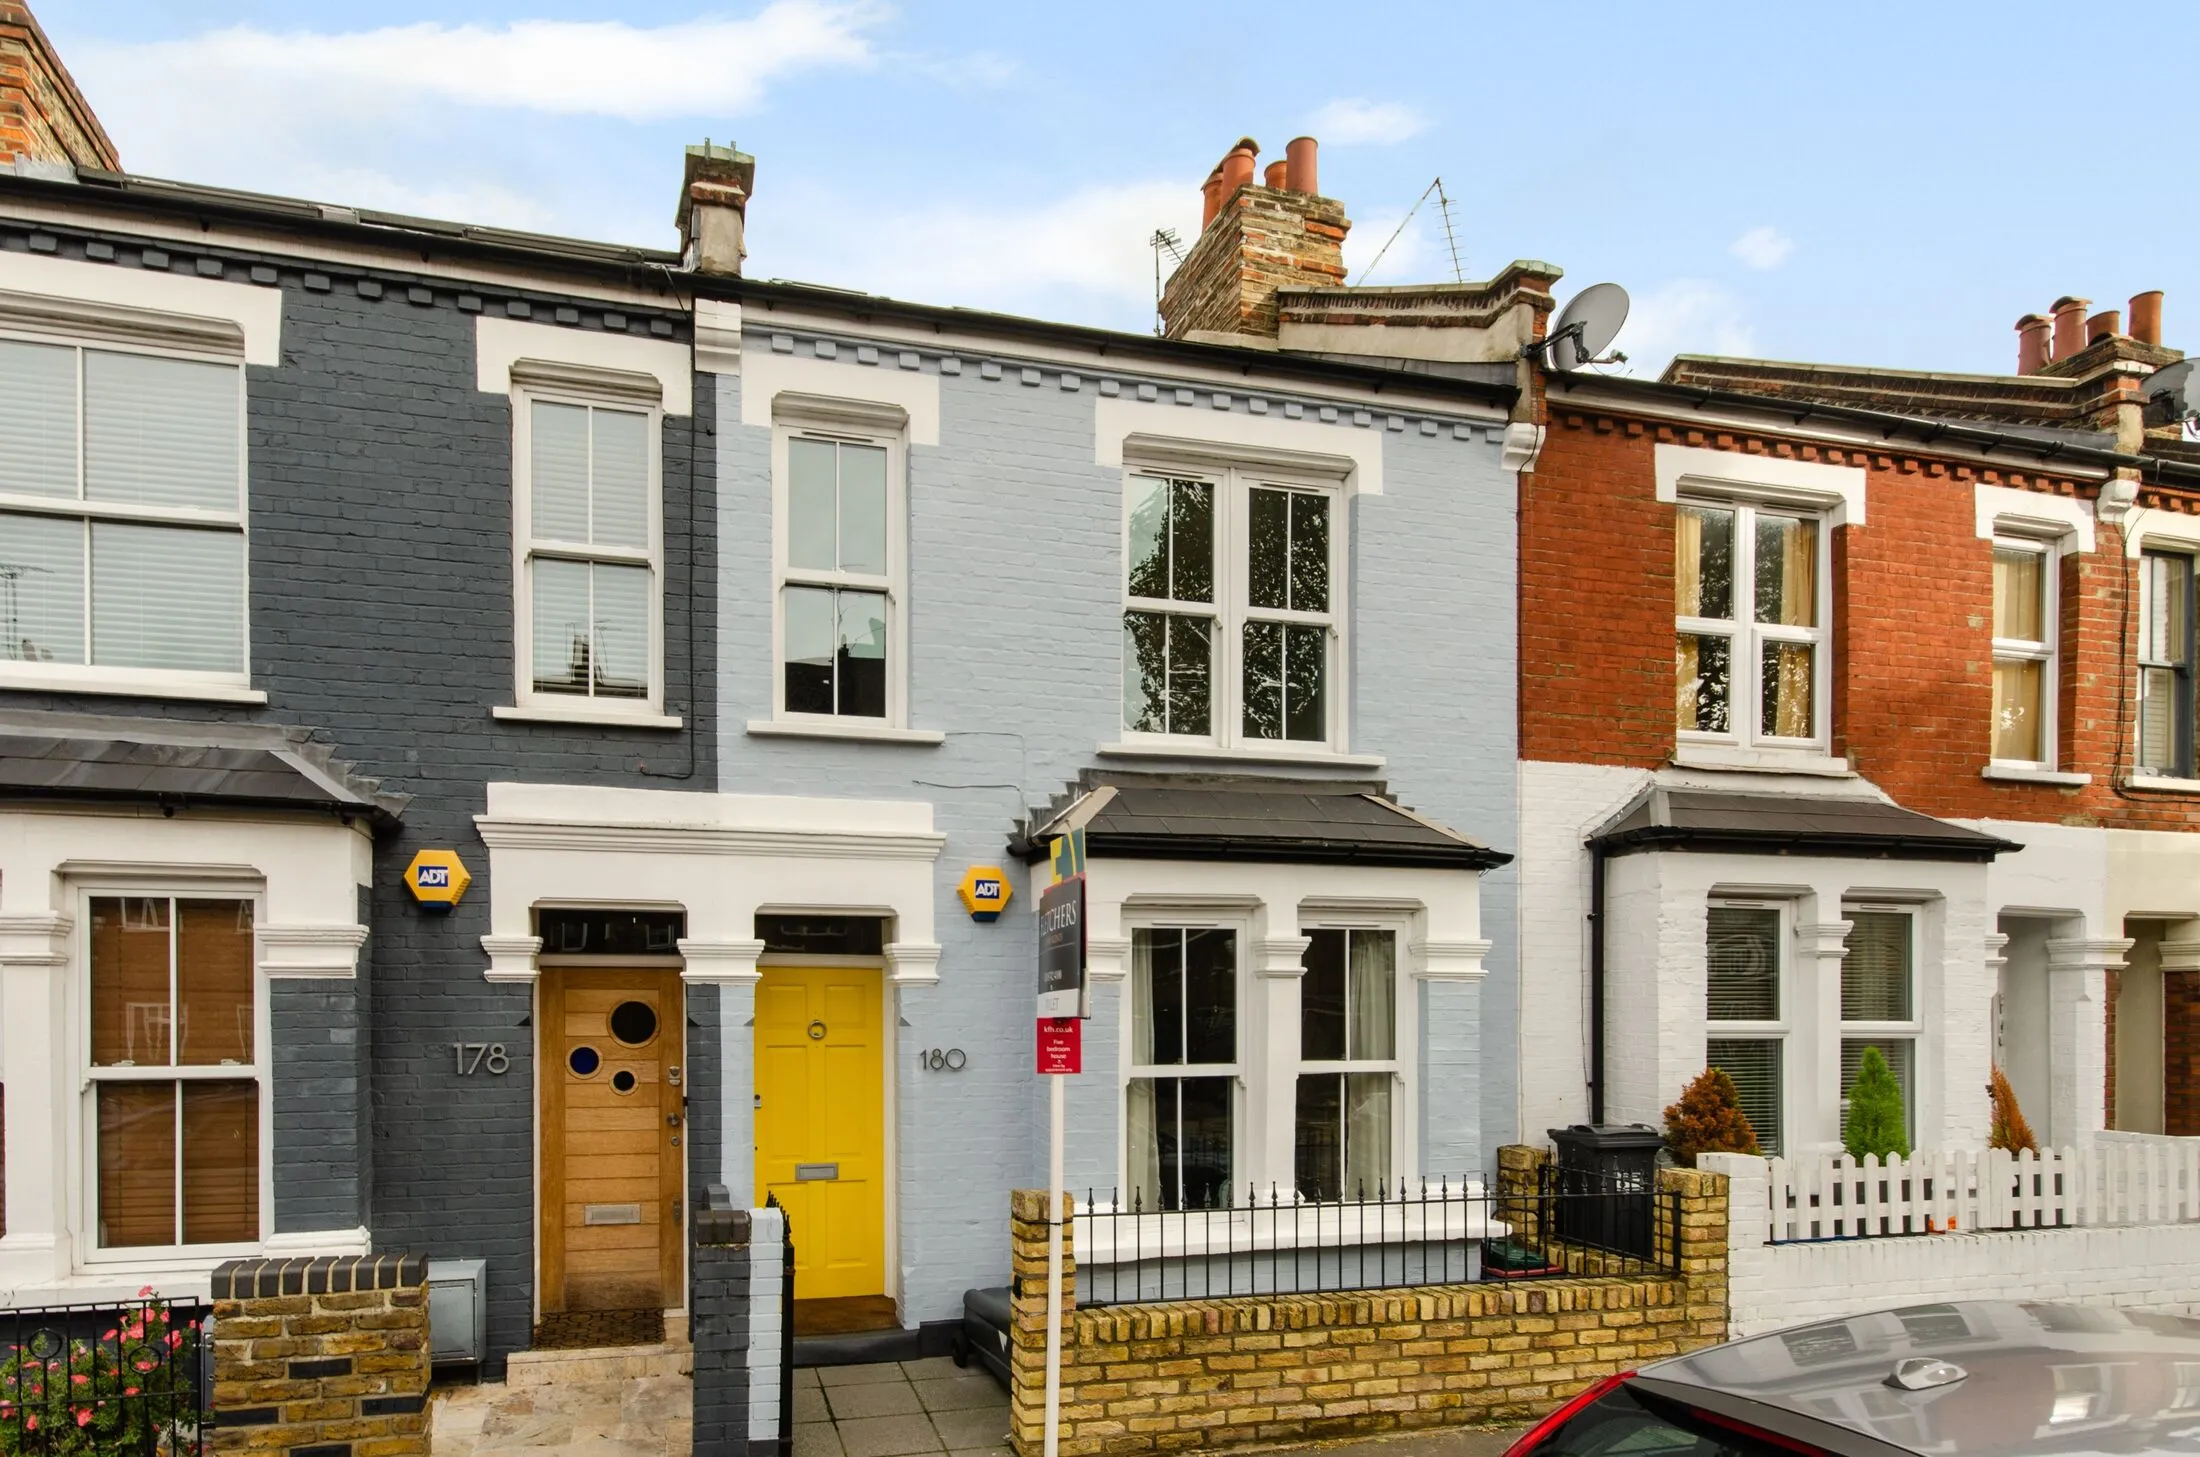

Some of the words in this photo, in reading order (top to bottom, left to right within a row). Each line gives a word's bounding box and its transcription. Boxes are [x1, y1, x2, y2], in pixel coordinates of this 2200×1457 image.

[418, 869, 448, 884] ADT
[975, 882, 1000, 896] ADT
[453, 1043, 510, 1075] 178
[920, 1048, 966, 1070] 180
